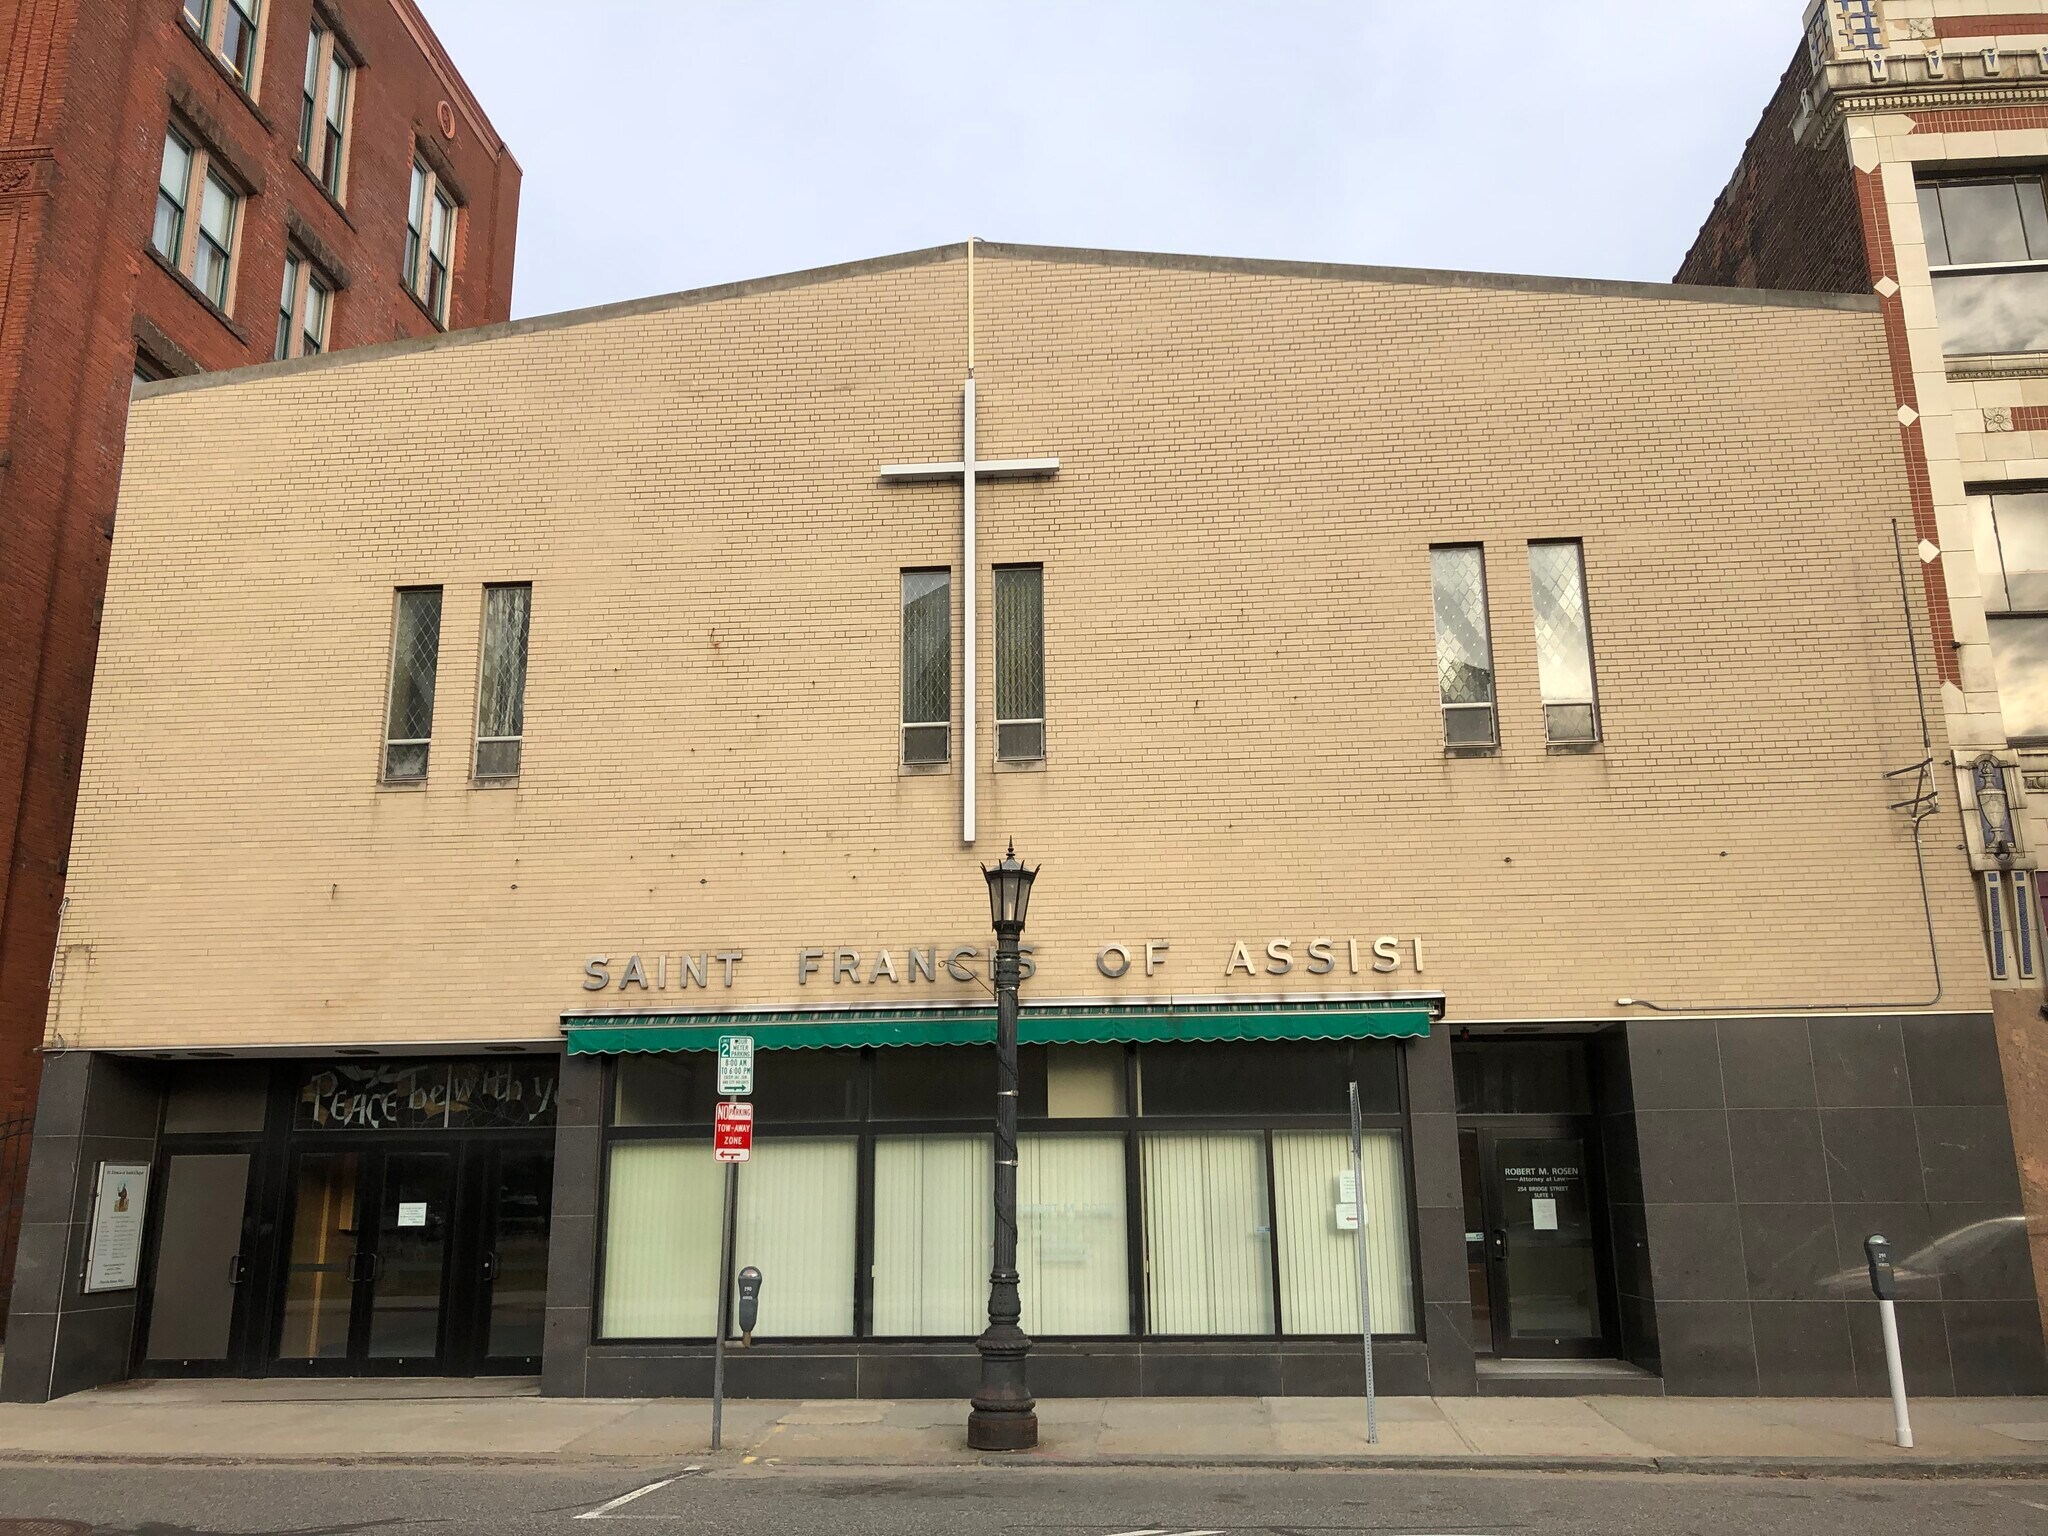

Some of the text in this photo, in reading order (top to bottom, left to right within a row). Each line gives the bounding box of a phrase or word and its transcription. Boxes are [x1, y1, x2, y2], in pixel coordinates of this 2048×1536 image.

[583, 937, 1424, 991] SAINT FRANCIS OF ASSISI
[721, 1043, 729, 1057] 2
[721, 1067, 752, 1075] TO 6:00 PM
[717, 1105, 751, 1120] NO PARKING
[717, 1123, 751, 1133] TOW-AWAY
[723, 1136, 743, 1145] ZONE
[1504, 1167, 1536, 1176] ROBERT
[1552, 1167, 1579, 1175] ROSEN
